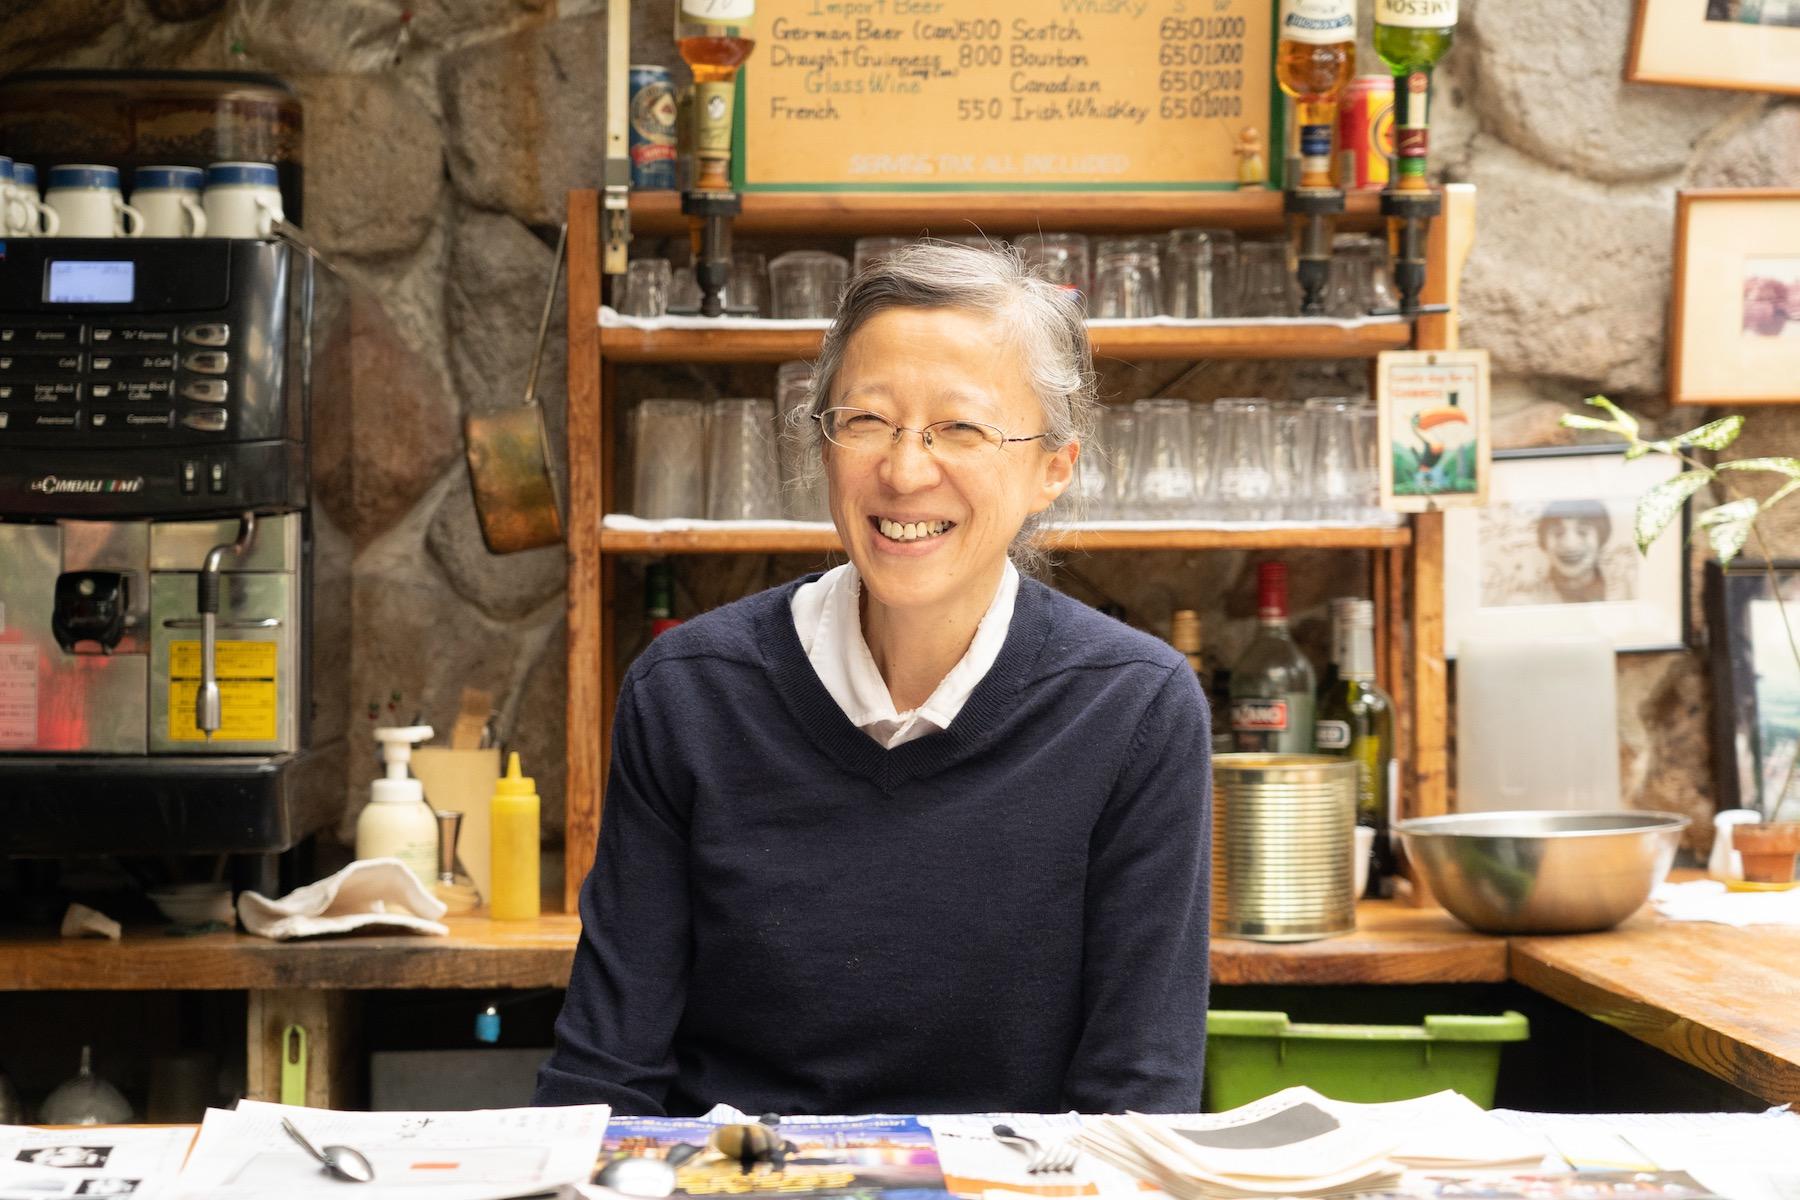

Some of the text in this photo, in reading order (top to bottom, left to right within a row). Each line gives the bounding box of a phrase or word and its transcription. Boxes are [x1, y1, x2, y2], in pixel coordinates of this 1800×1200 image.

[772, 17, 851, 41] German
[856, 19, 904, 41] Beer
[959, 19, 1002, 41] 500
[1011, 16, 1247, 41] Scotch 650 1000
[853, 45, 942, 69] Guinness
[958, 44, 1003, 68] 800
[1010, 43, 1244, 67] Bourbon 650 1000
[804, 71, 922, 95] Glass Wine
[1010, 72, 1101, 93] Canadian
[1158, 70, 1203, 92] 650
[770, 97, 1003, 121] French 550
[1010, 97, 1062, 121] Irish
[1159, 97, 1203, 119] 650
